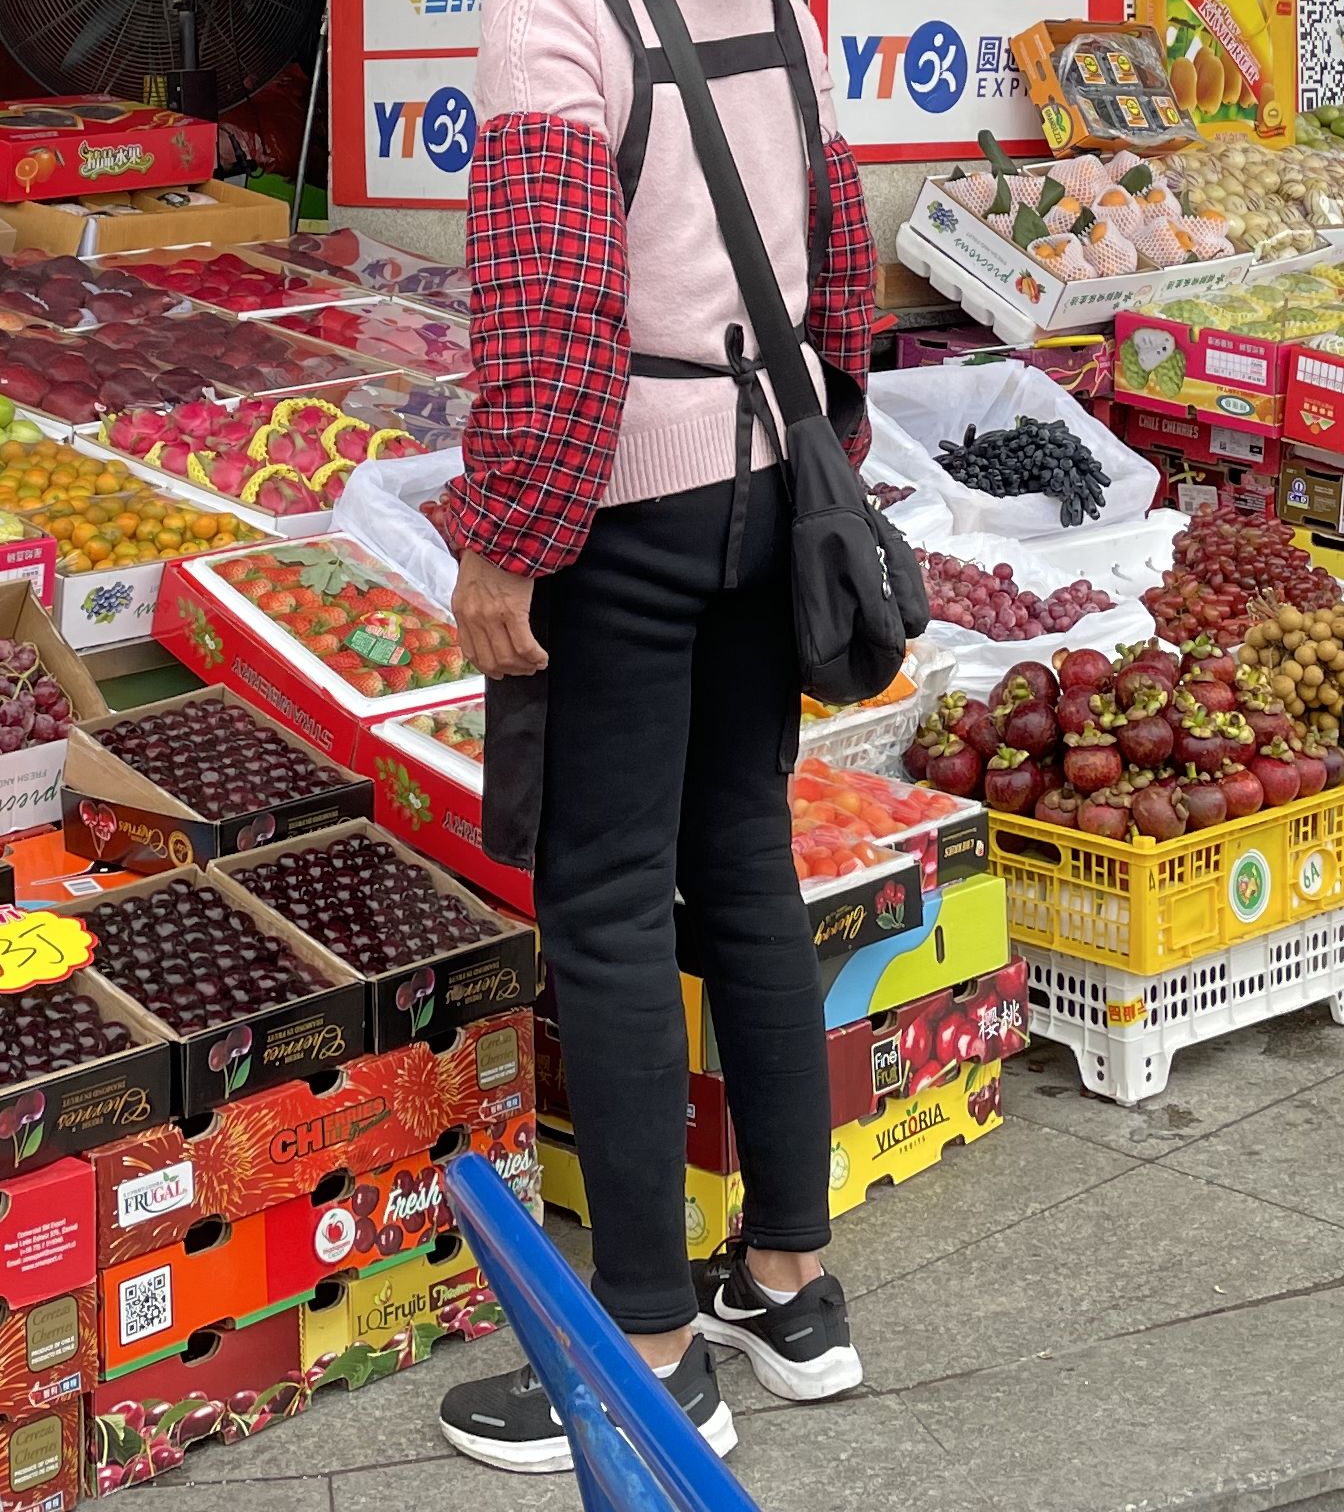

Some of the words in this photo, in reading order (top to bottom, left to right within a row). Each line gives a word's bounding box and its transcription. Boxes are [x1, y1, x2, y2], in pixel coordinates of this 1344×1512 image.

[83, 142, 145, 172] 精品水果
[1138, 413, 1160, 430] CHILE
[1162, 419, 1200, 440] CHERRIES
[231, 655, 335, 752] STRAWBERRY
[264, 1023, 346, 1066] Cherries
[873, 1048, 898, 1070] Fine
[58, 1088, 151, 1132] Cherries
[874, 1100, 946, 1155] VICTORIA
[123, 1186, 188, 1215] FRUGAL
[383, 1173, 443, 1224] Fresh
